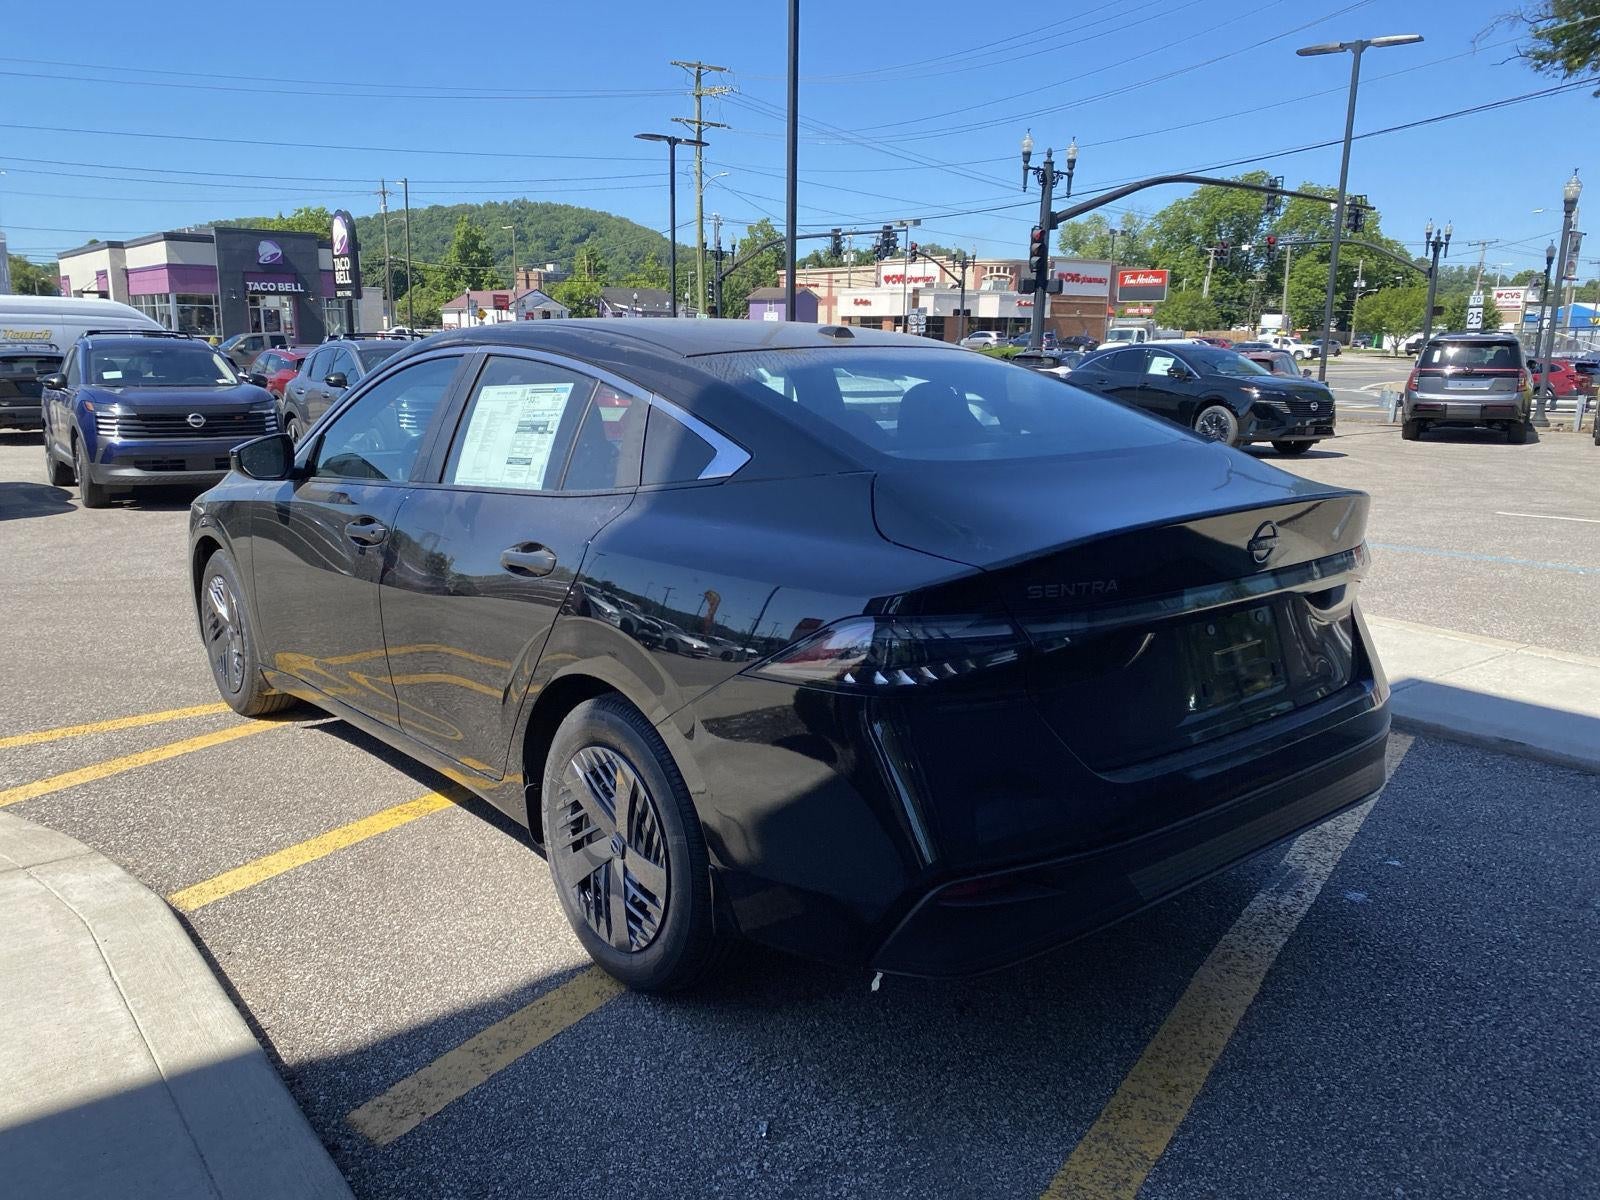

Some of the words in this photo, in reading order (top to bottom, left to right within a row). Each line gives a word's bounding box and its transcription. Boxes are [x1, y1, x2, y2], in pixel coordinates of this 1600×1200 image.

[333, 257, 350, 271] TACO
[335, 271, 352, 284] BELL
[1065, 273, 1081, 282] CVS
[1124, 275, 1137, 285] Tim
[1136, 273, 1162, 284] Hortons
[246, 281, 276, 292] TACO
[278, 282, 304, 292] BELL
[1467, 312, 1482, 325] 25
[1027, 579, 1119, 600] SENTRA
